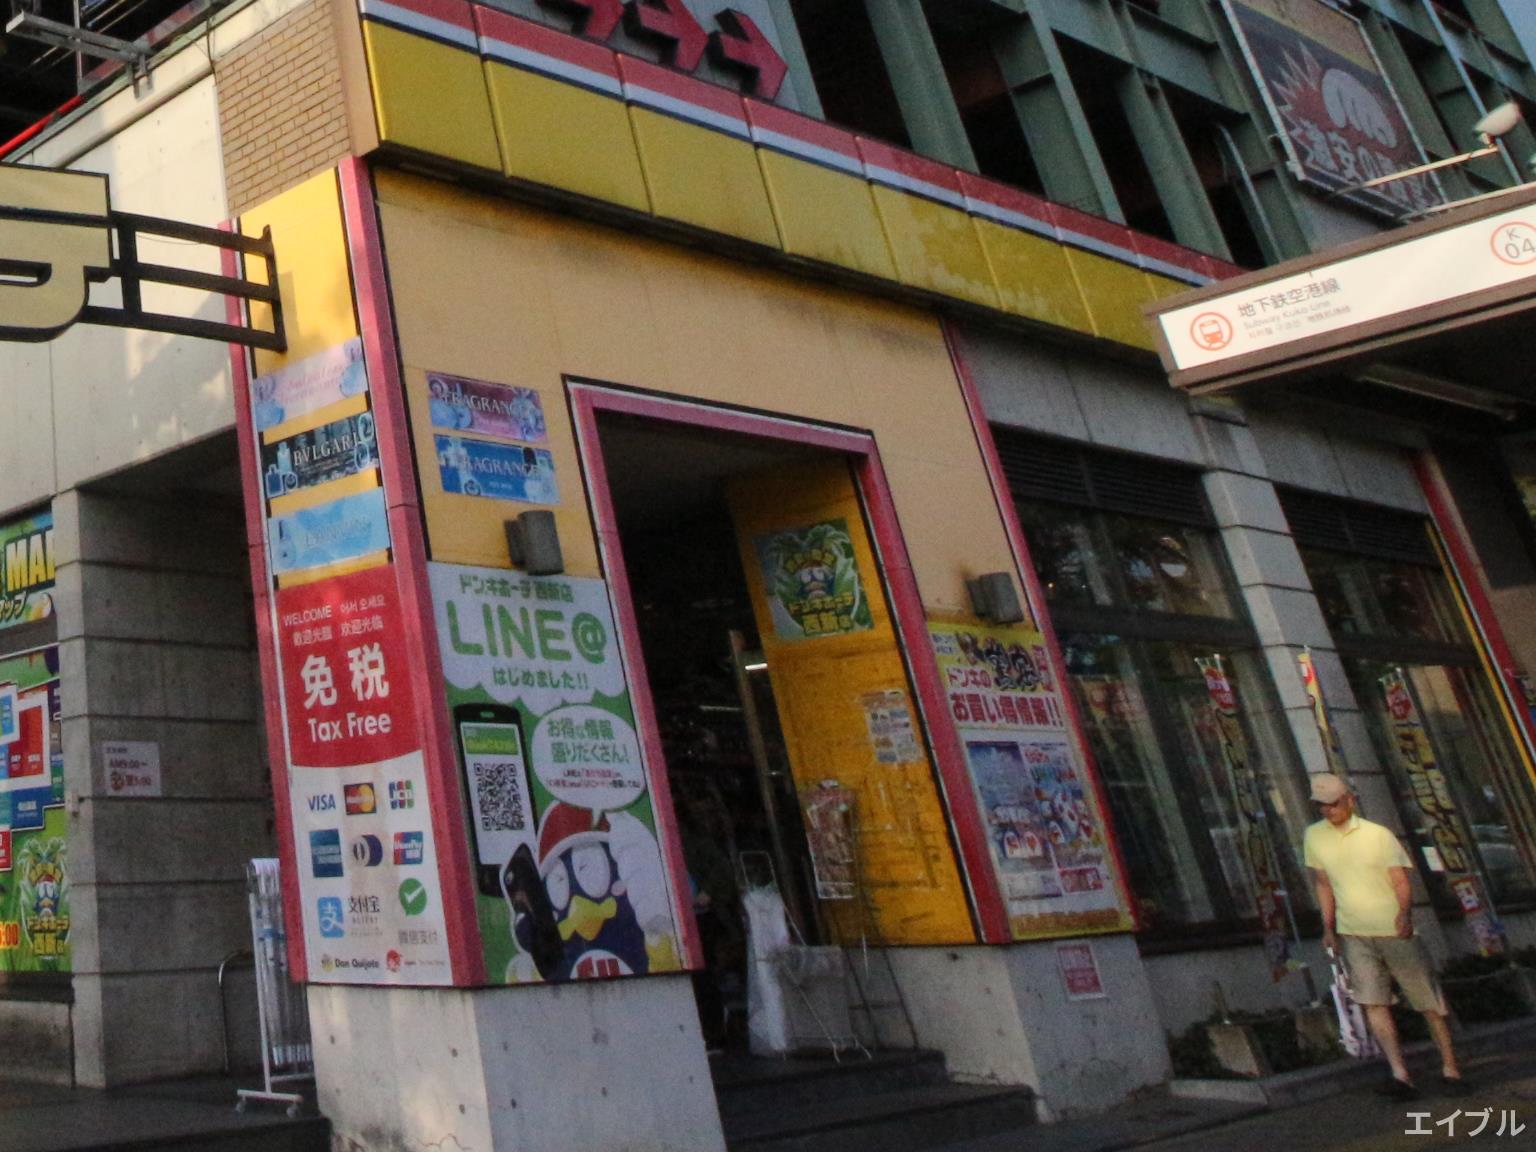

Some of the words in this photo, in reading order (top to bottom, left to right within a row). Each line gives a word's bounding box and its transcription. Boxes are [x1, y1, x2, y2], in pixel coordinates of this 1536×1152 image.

[1237, 277, 1343, 318] 地下鉄空港線
[283, 604, 333, 627] WELCOME
[307, 717, 344, 743] Tax
[346, 711, 392, 738] Free
[308, 793, 337, 812] VISA
